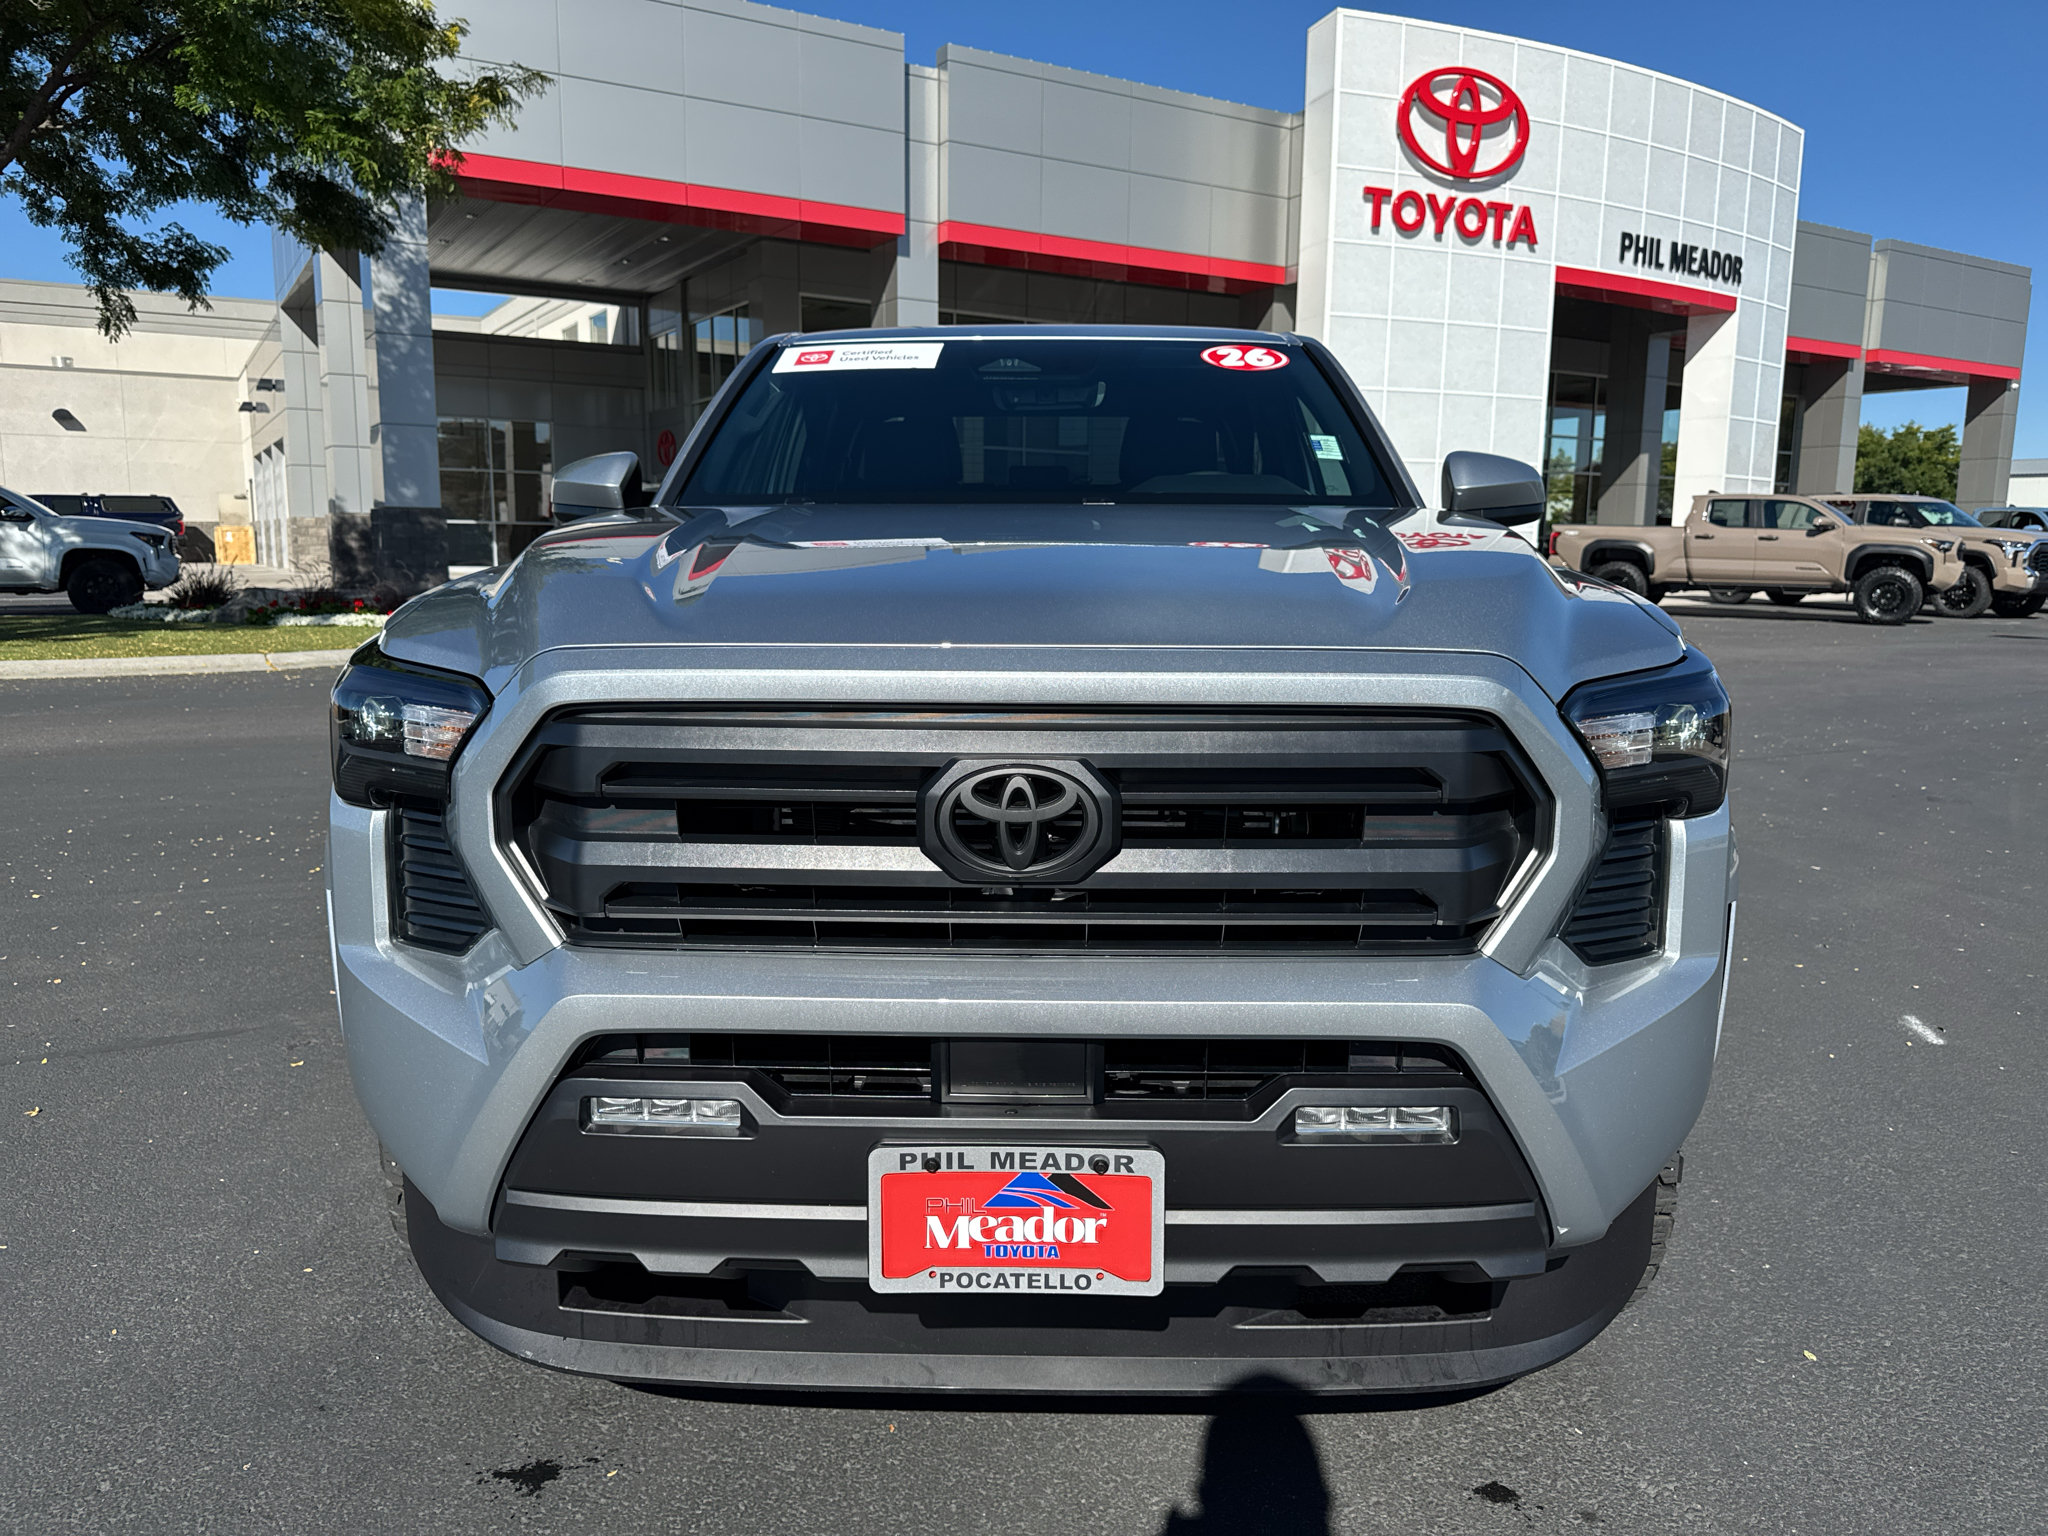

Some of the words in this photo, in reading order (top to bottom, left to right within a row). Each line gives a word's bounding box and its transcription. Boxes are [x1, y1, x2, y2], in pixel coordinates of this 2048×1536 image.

[1363, 186, 1538, 246] TOYOTA
[1619, 231, 1664, 271] PHIL
[1669, 241, 1743, 287] MEADOR
[1216, 348, 1276, 366] 26
[900, 1152, 975, 1171] PHIL
[990, 1152, 1135, 1174] MEADOR
[926, 1198, 987, 1214] PHIL
[924, 1206, 1107, 1249] Meador
[983, 1244, 1060, 1259] TOYOTA
[939, 1272, 1092, 1290] POCATELLO
